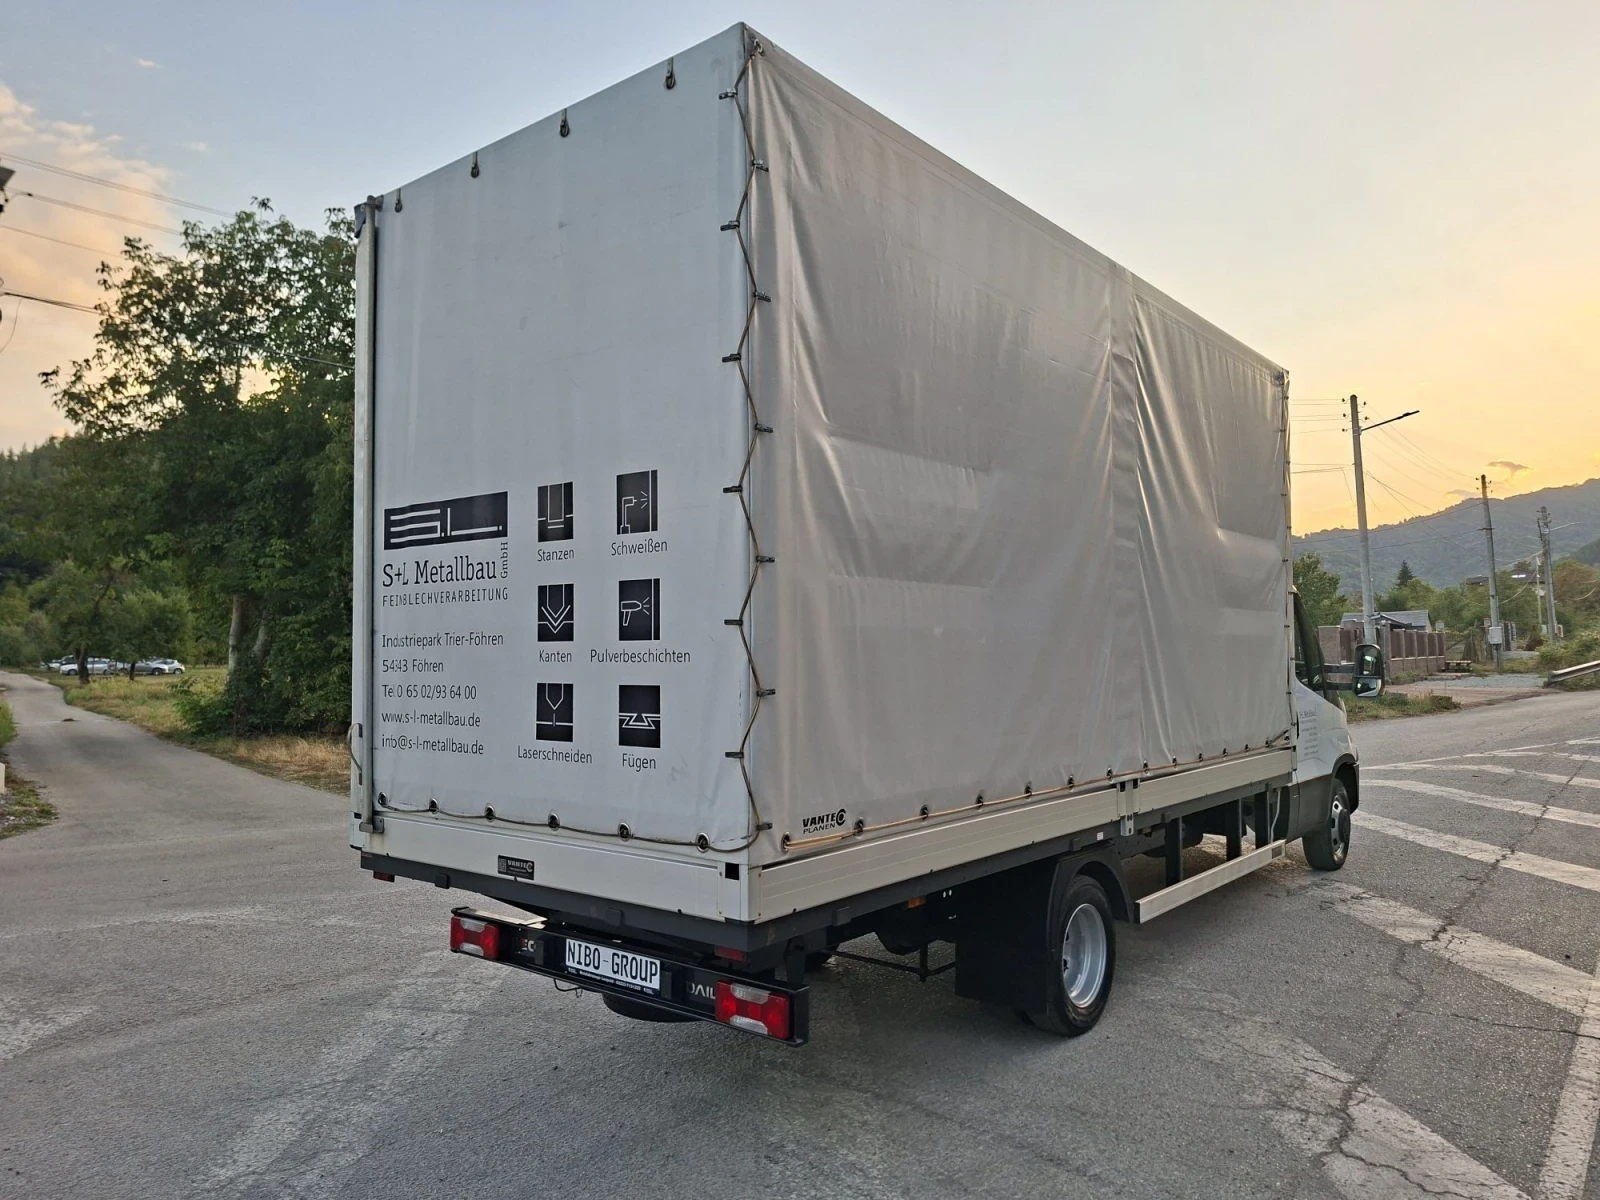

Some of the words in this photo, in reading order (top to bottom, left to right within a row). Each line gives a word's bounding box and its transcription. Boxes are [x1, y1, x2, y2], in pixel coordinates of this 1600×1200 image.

[537, 548, 575, 562] Stanzen
[611, 538, 668, 556] Schweißen
[500, 542, 508, 579] GmbH
[382, 562, 409, 587] S+L
[414, 555, 497, 585] Metallbau
[444, 631, 504, 646] Trier-Föhren
[538, 649, 572, 663] Kanten
[590, 648, 691, 664] Pulverbeschichten
[412, 658, 444, 673] Föhren
[406, 684, 418, 698] 65
[421, 684, 447, 700] 02/93
[449, 685, 461, 699] 64
[464, 685, 477, 699] 00
[381, 710, 481, 727] www.s-l-metallbau.de
[517, 745, 592, 764] Laserschneiden
[622, 753, 657, 772] Fügen
[802, 808, 847, 828] VANTEC
[803, 822, 836, 835] PLANEN
[689, 982, 716, 1000] DAIL
